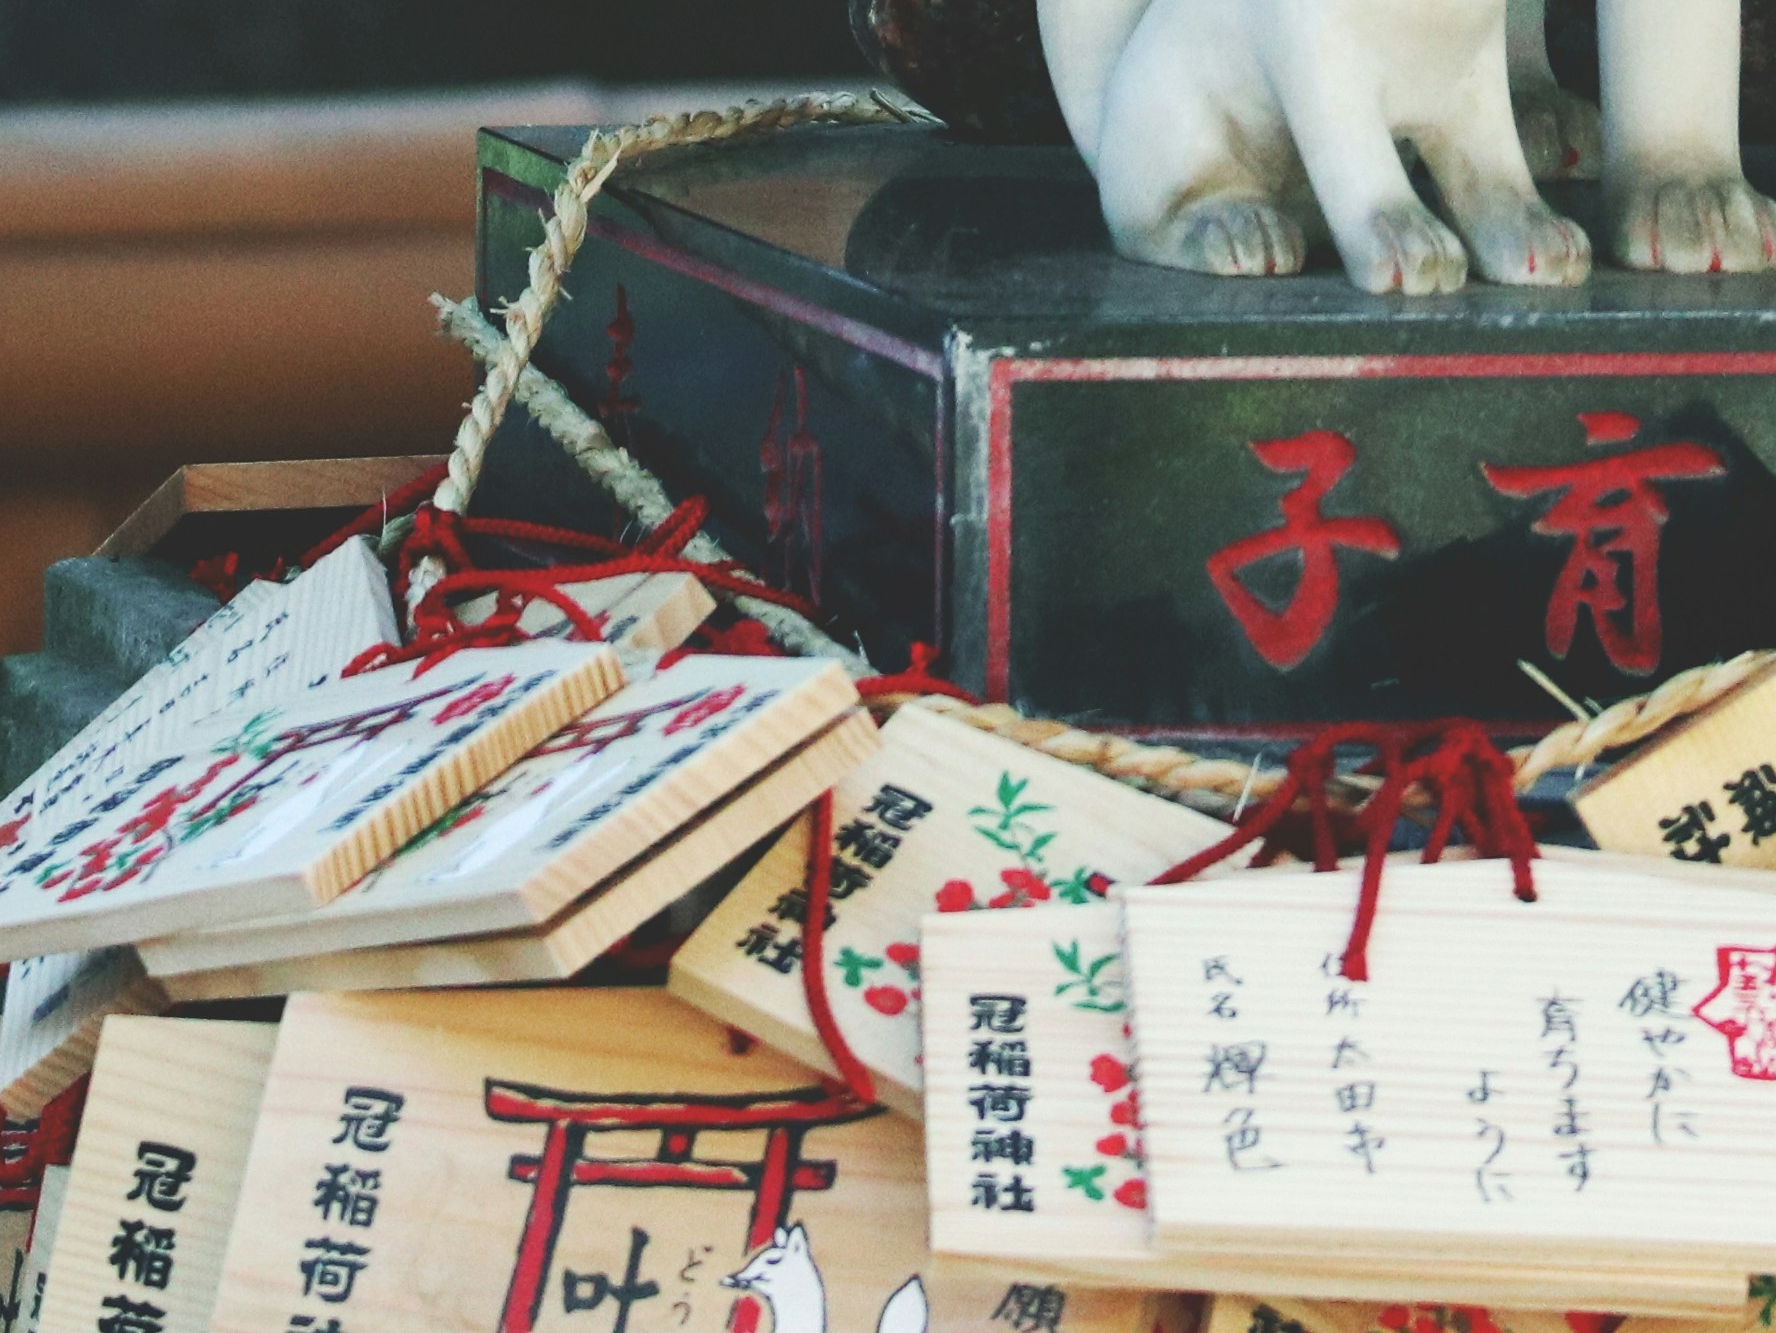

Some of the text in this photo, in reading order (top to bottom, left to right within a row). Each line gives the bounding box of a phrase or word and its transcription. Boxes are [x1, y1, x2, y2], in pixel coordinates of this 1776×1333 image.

[289, 1085, 406, 1333] 冠稲荷
[968, 994, 1035, 1213] 冠稲荷神社
[1467, 1070, 1514, 1203] ように
